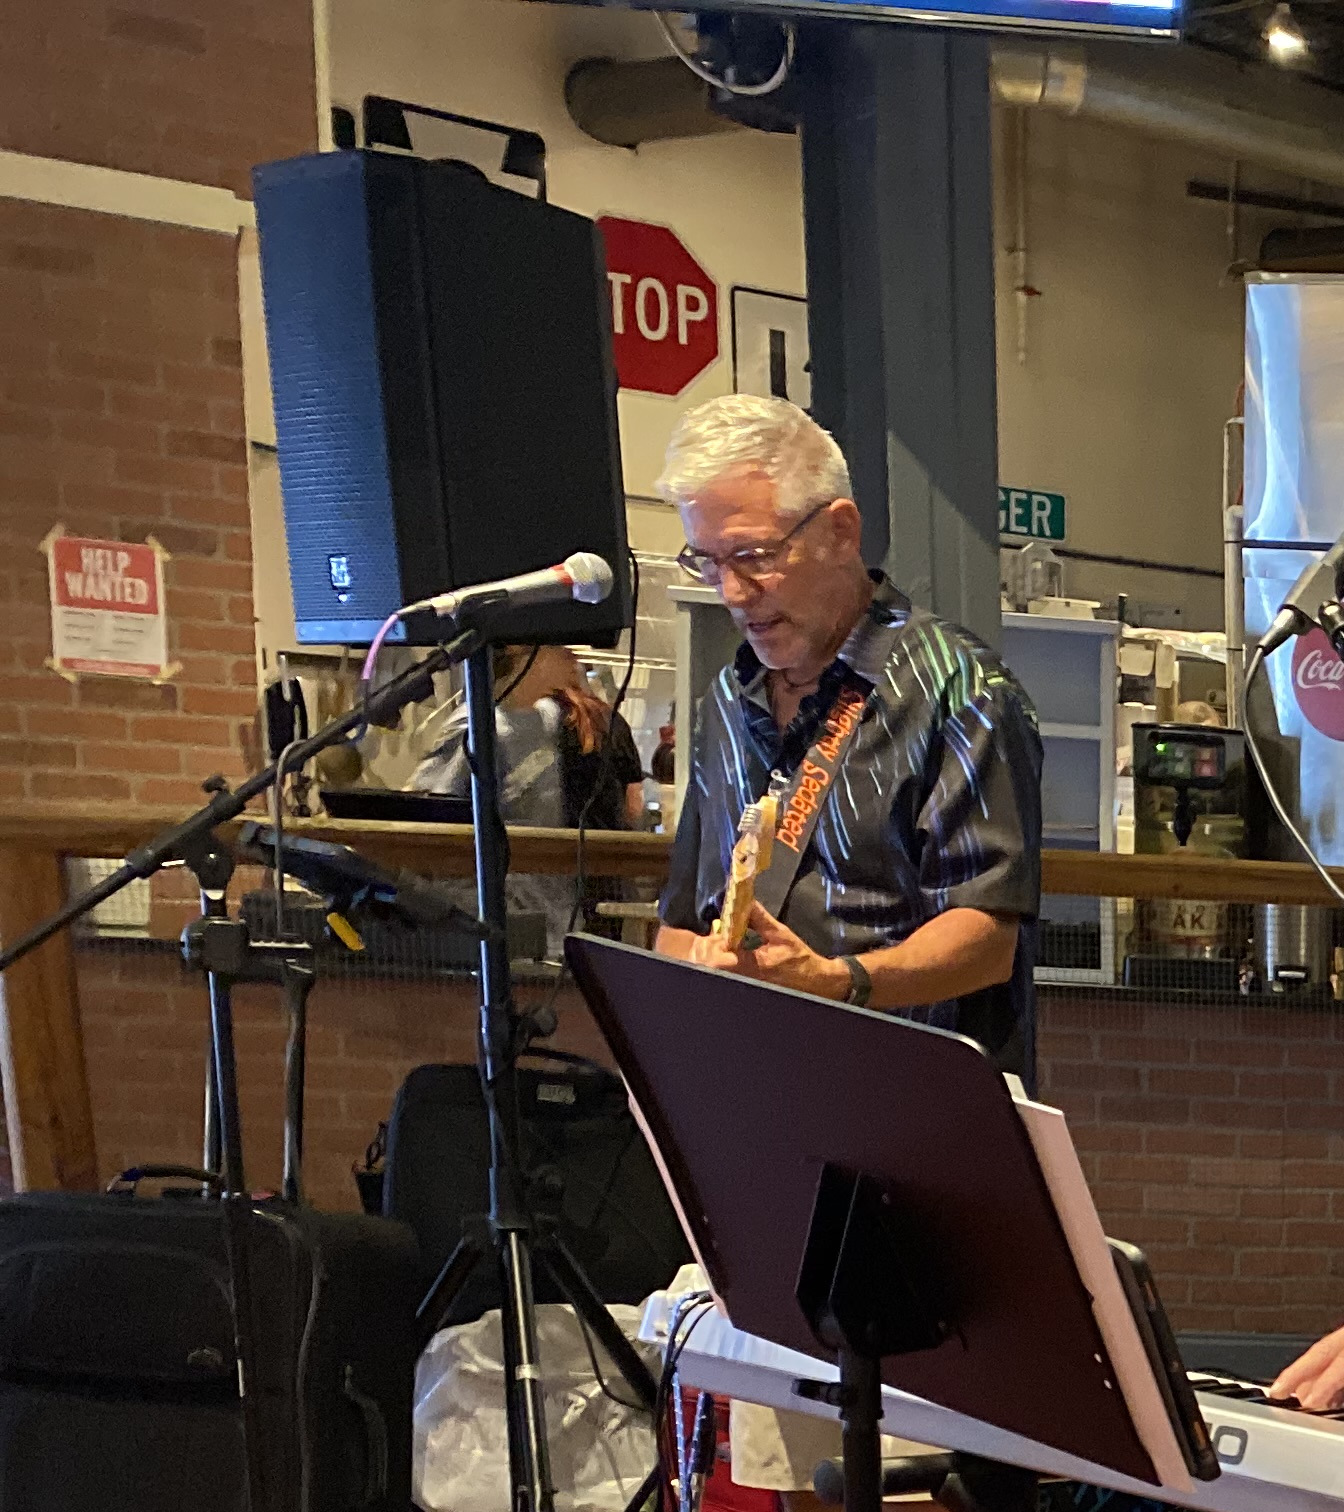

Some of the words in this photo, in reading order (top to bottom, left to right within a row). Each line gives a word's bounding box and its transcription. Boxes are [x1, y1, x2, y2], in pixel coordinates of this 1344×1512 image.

[607, 271, 709, 345] TOP
[64, 571, 148, 606] WANTED
[80, 547, 131, 578] HELP
[775, 758, 831, 853] Sedated
